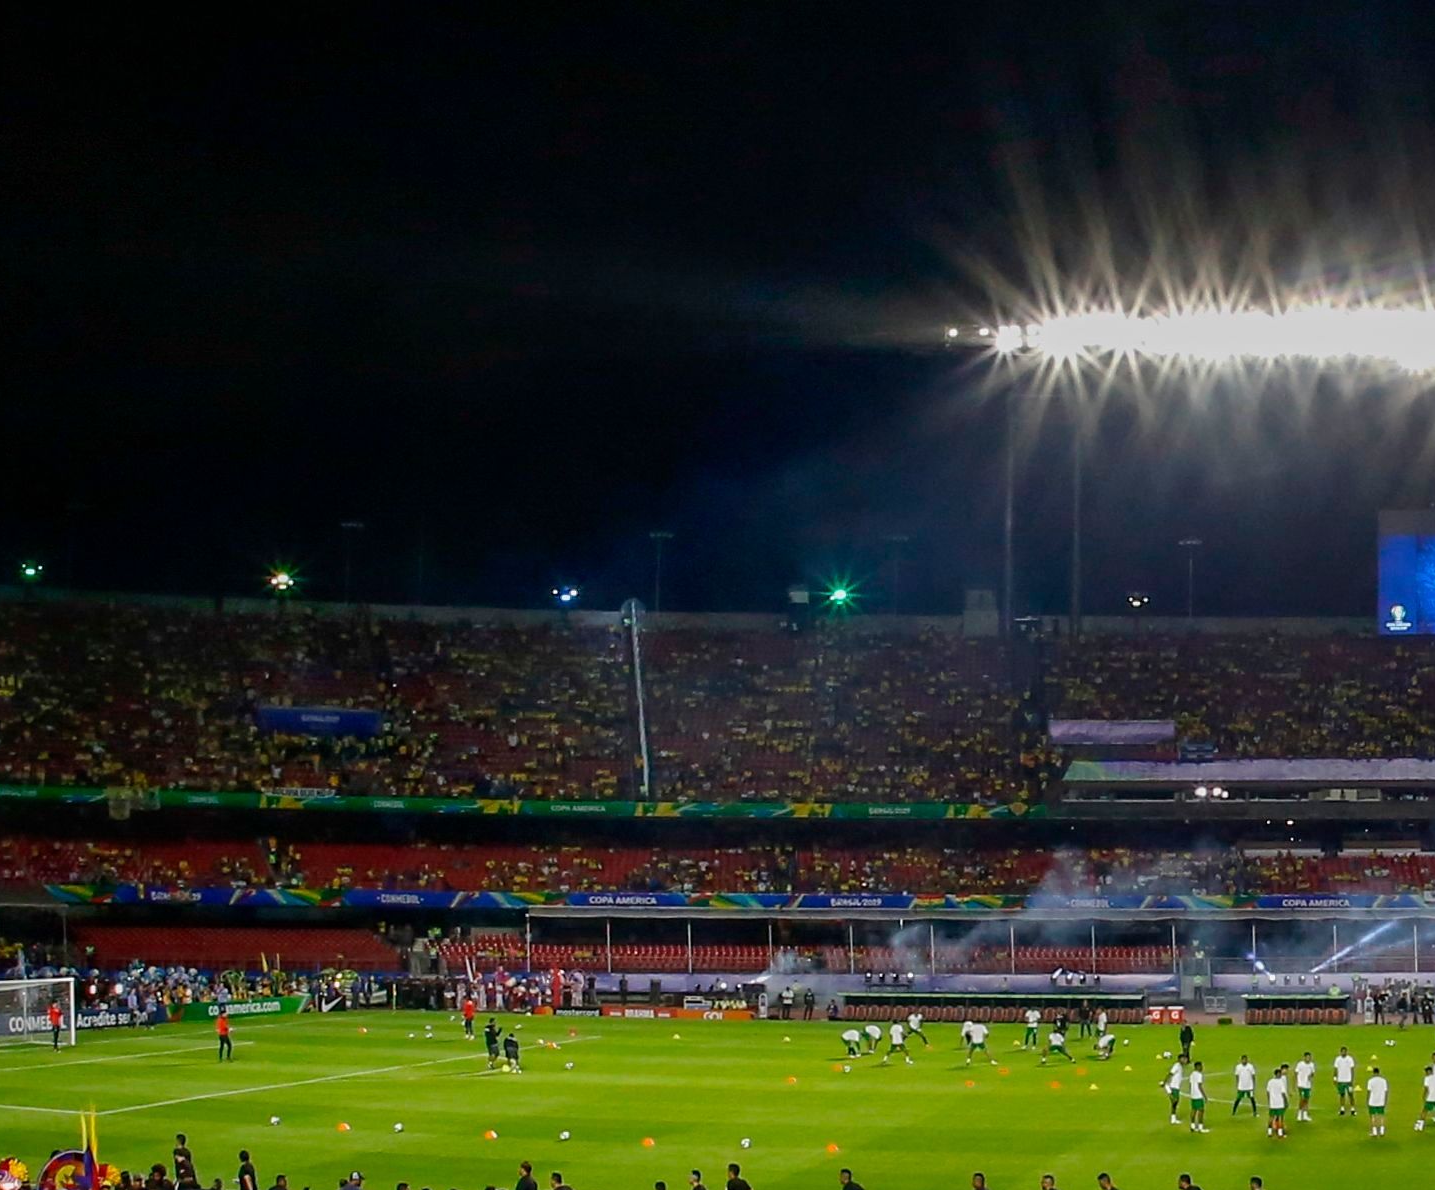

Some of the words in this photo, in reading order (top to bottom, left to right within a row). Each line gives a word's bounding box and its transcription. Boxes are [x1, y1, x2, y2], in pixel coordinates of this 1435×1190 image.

[381, 893, 420, 904] CONMEBOL
[589, 896, 614, 904] COPA
[615, 896, 657, 905] AMERICA
[1282, 898, 1307, 907] COPA
[1309, 898, 1350, 907] AMERICA
[556, 1008, 600, 1017] mastercard
[624, 1008, 655, 1018] BRAHMA
[1152, 1010, 1161, 1020] G
[1170, 1010, 1180, 1020] G
[9, 1013, 67, 1033] CONMEBL
[76, 1010, 117, 1028] Acredite
